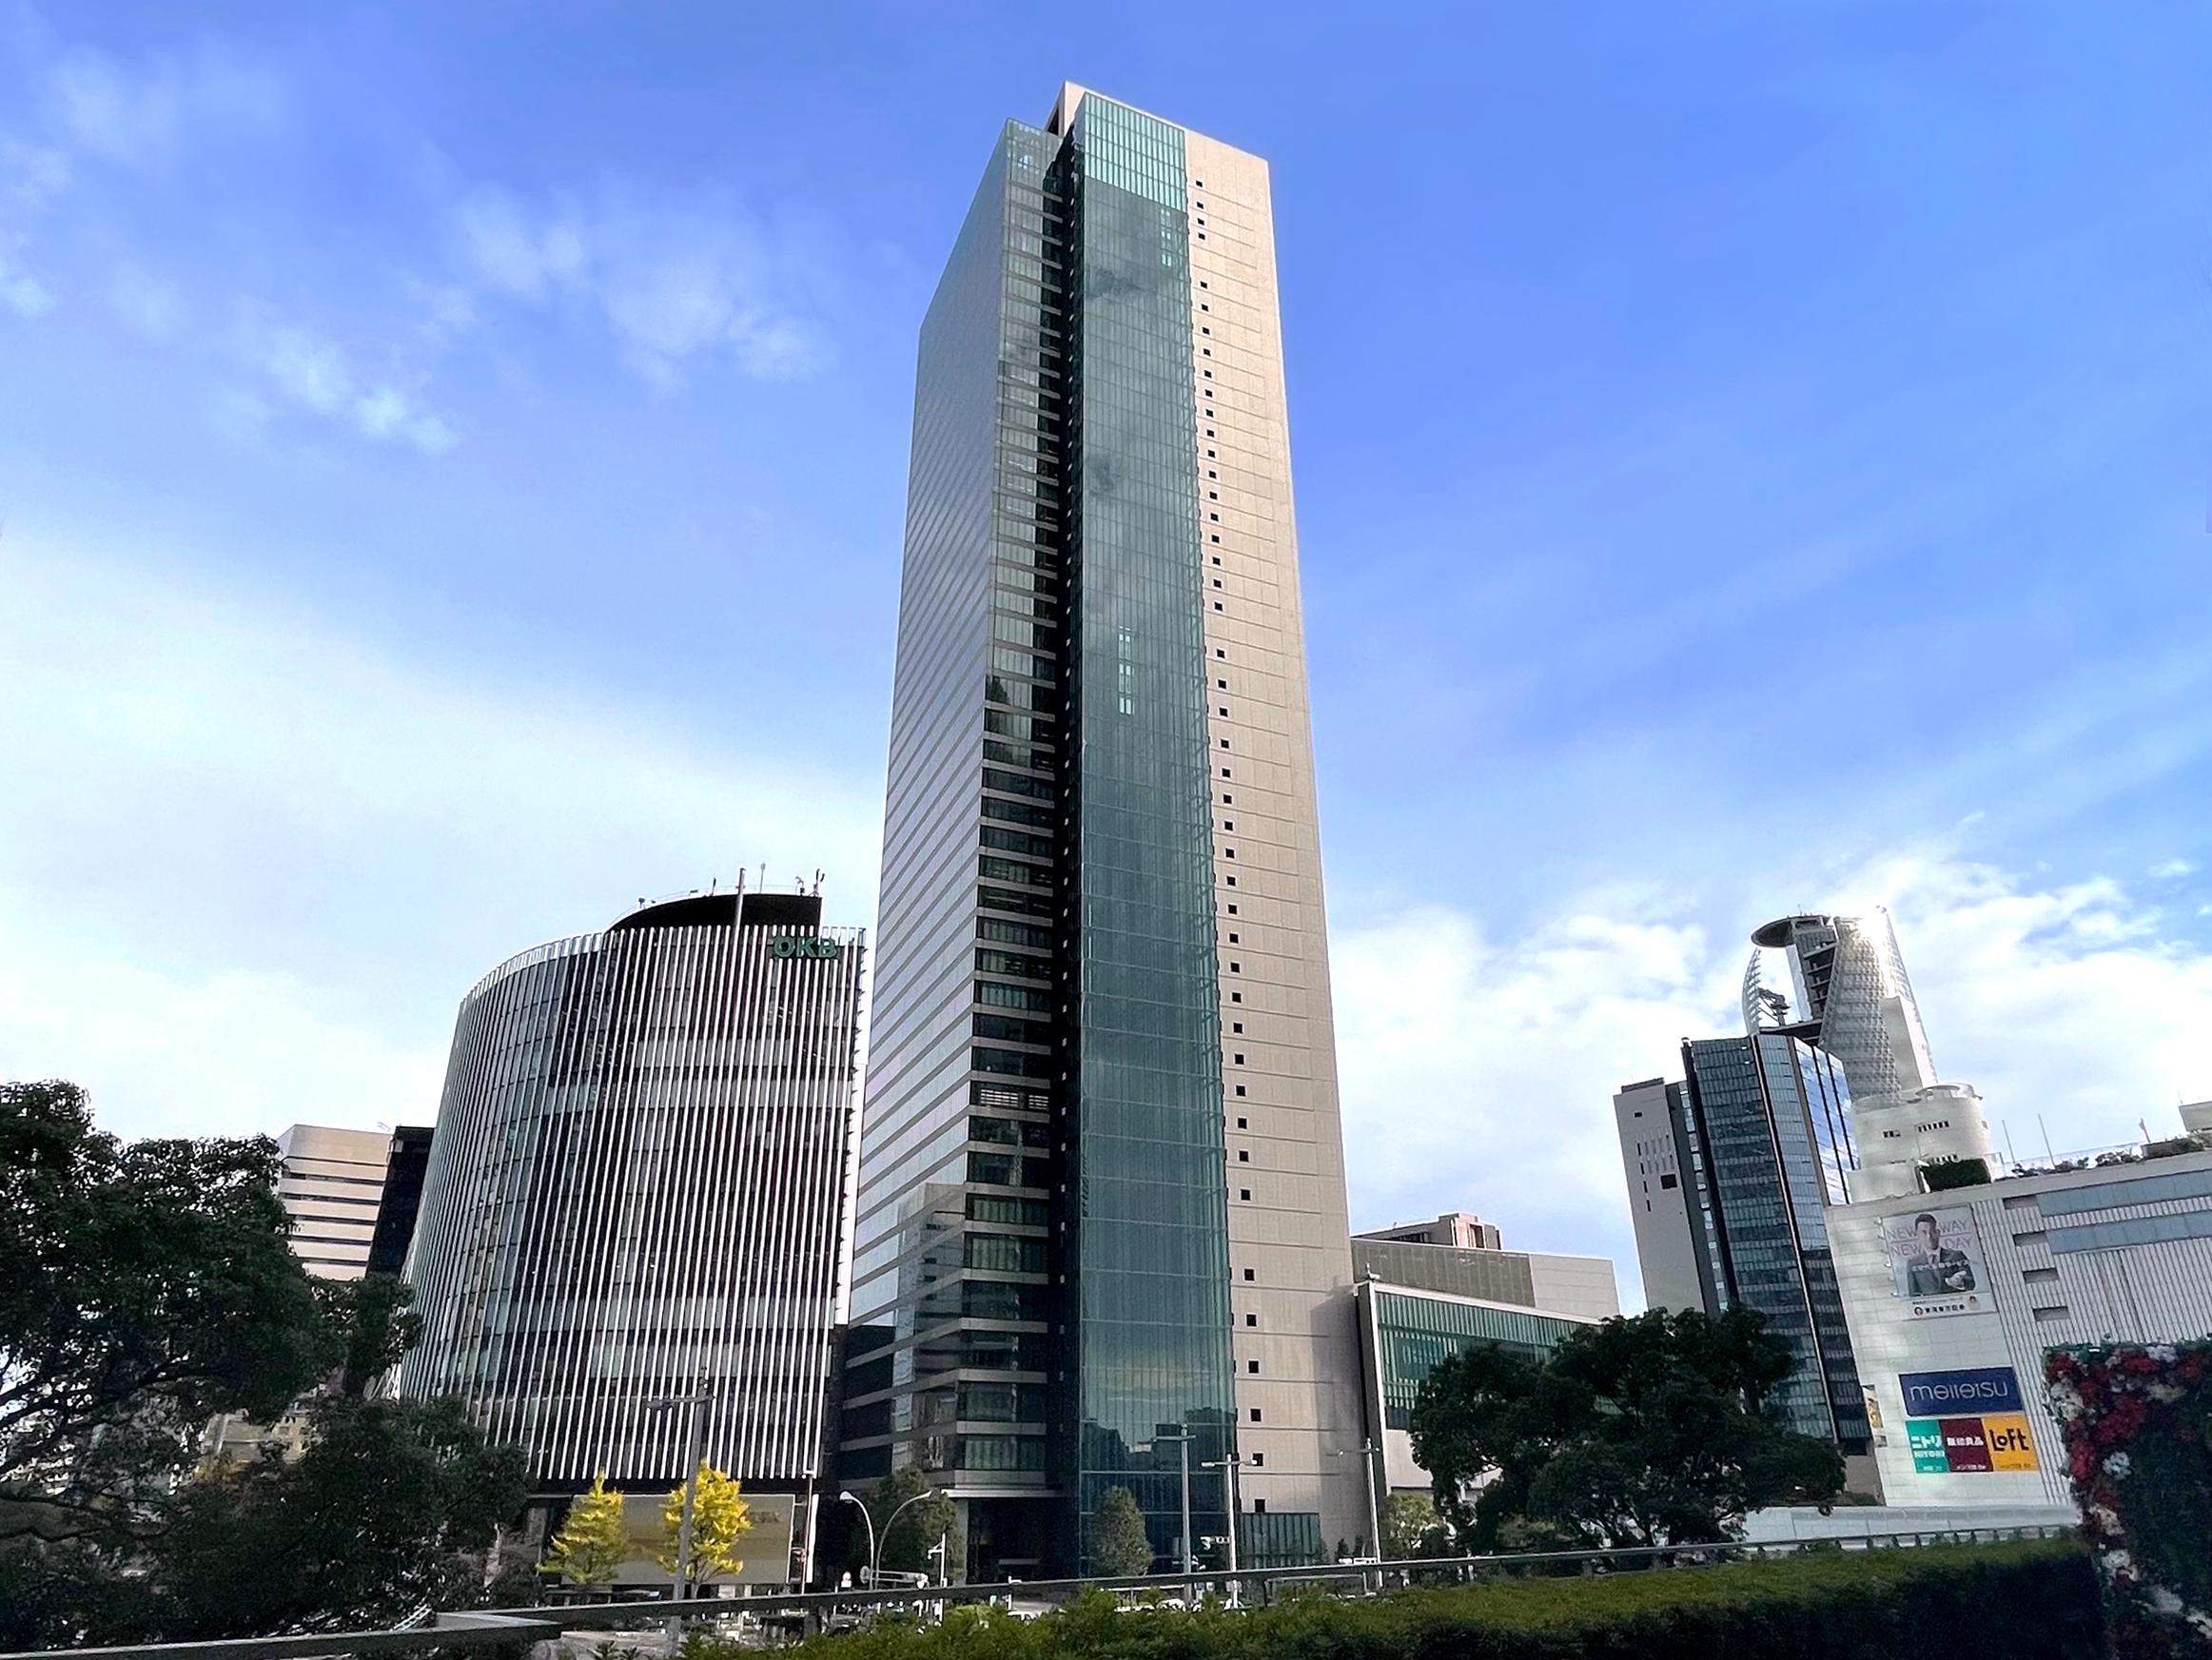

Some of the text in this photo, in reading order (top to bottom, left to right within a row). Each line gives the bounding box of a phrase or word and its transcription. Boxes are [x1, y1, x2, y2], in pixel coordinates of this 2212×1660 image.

[773, 936, 837, 958] OKB
[1887, 1220, 1967, 1240] NEW WAY
[1890, 1236, 1972, 1257] NEW DAY
[1910, 1435, 1942, 1449] ニトリ
